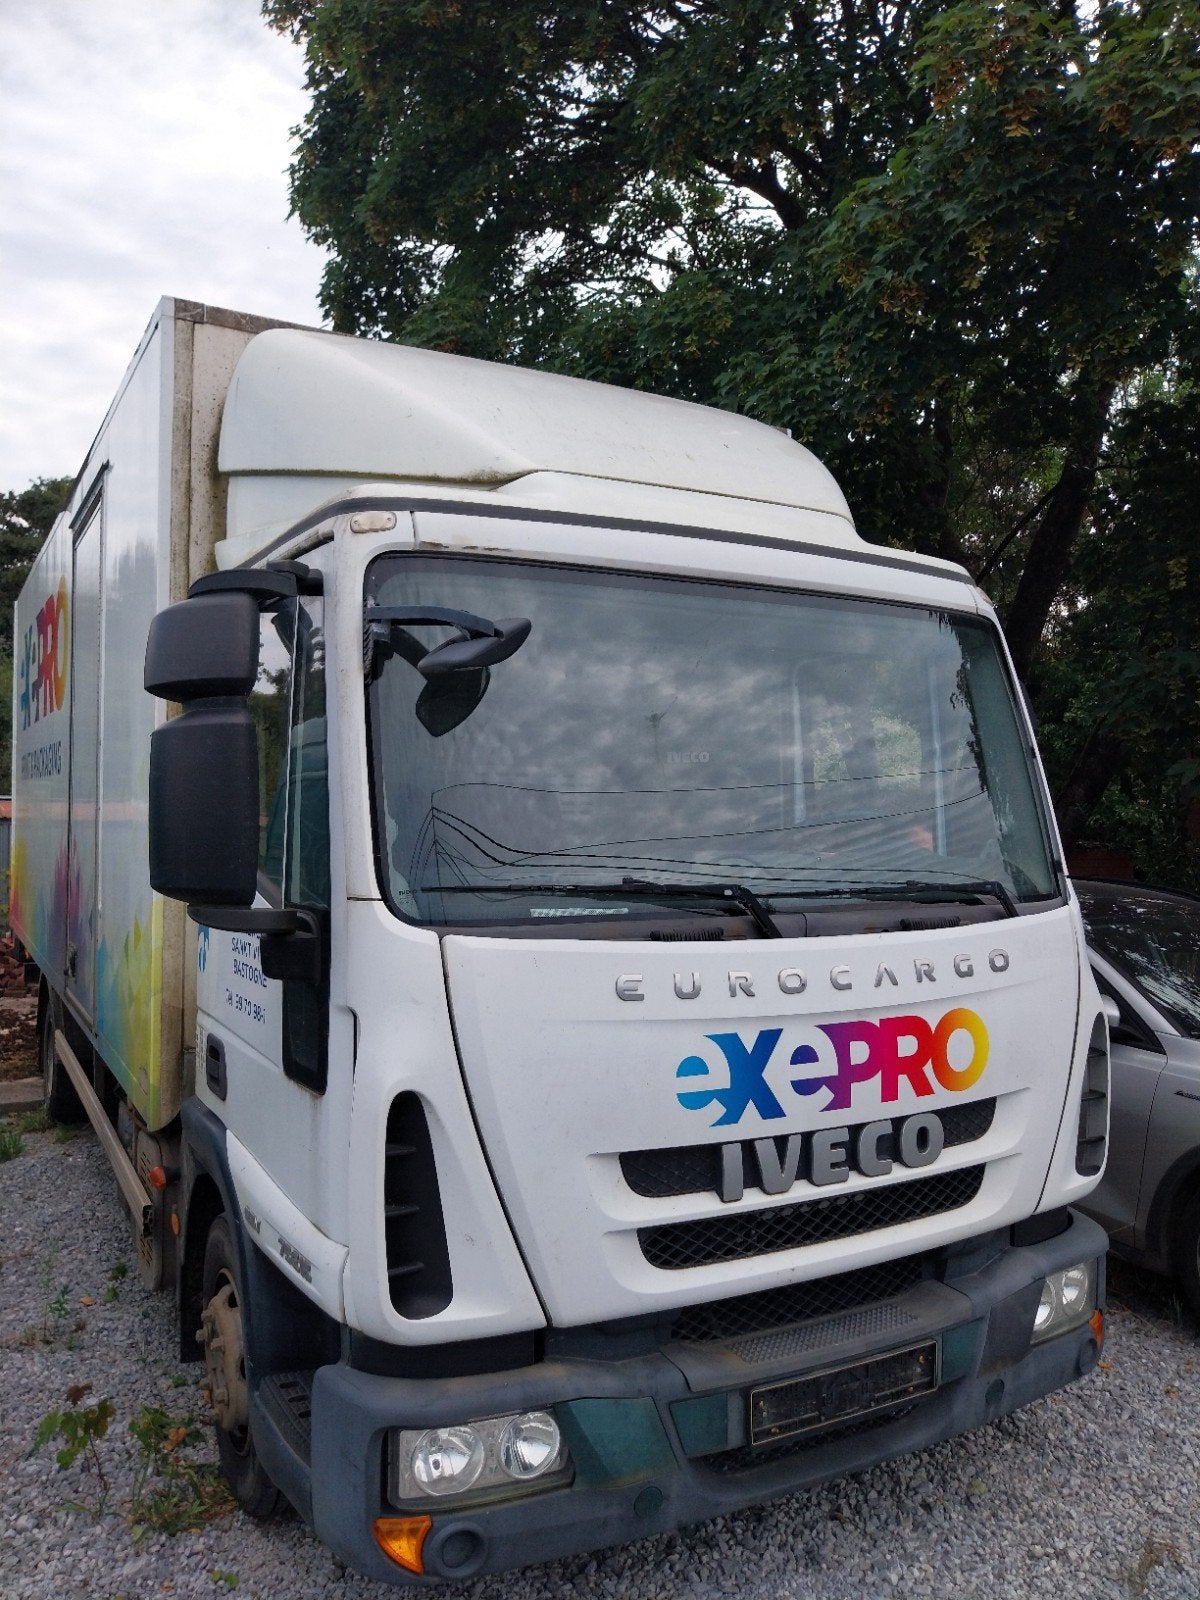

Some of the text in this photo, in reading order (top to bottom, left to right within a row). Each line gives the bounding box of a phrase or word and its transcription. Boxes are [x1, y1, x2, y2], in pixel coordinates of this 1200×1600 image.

[666, 751, 710, 763] IVECO
[615, 948, 1010, 1001] EUROCARGO
[719, 1112, 945, 1204] IVECO
